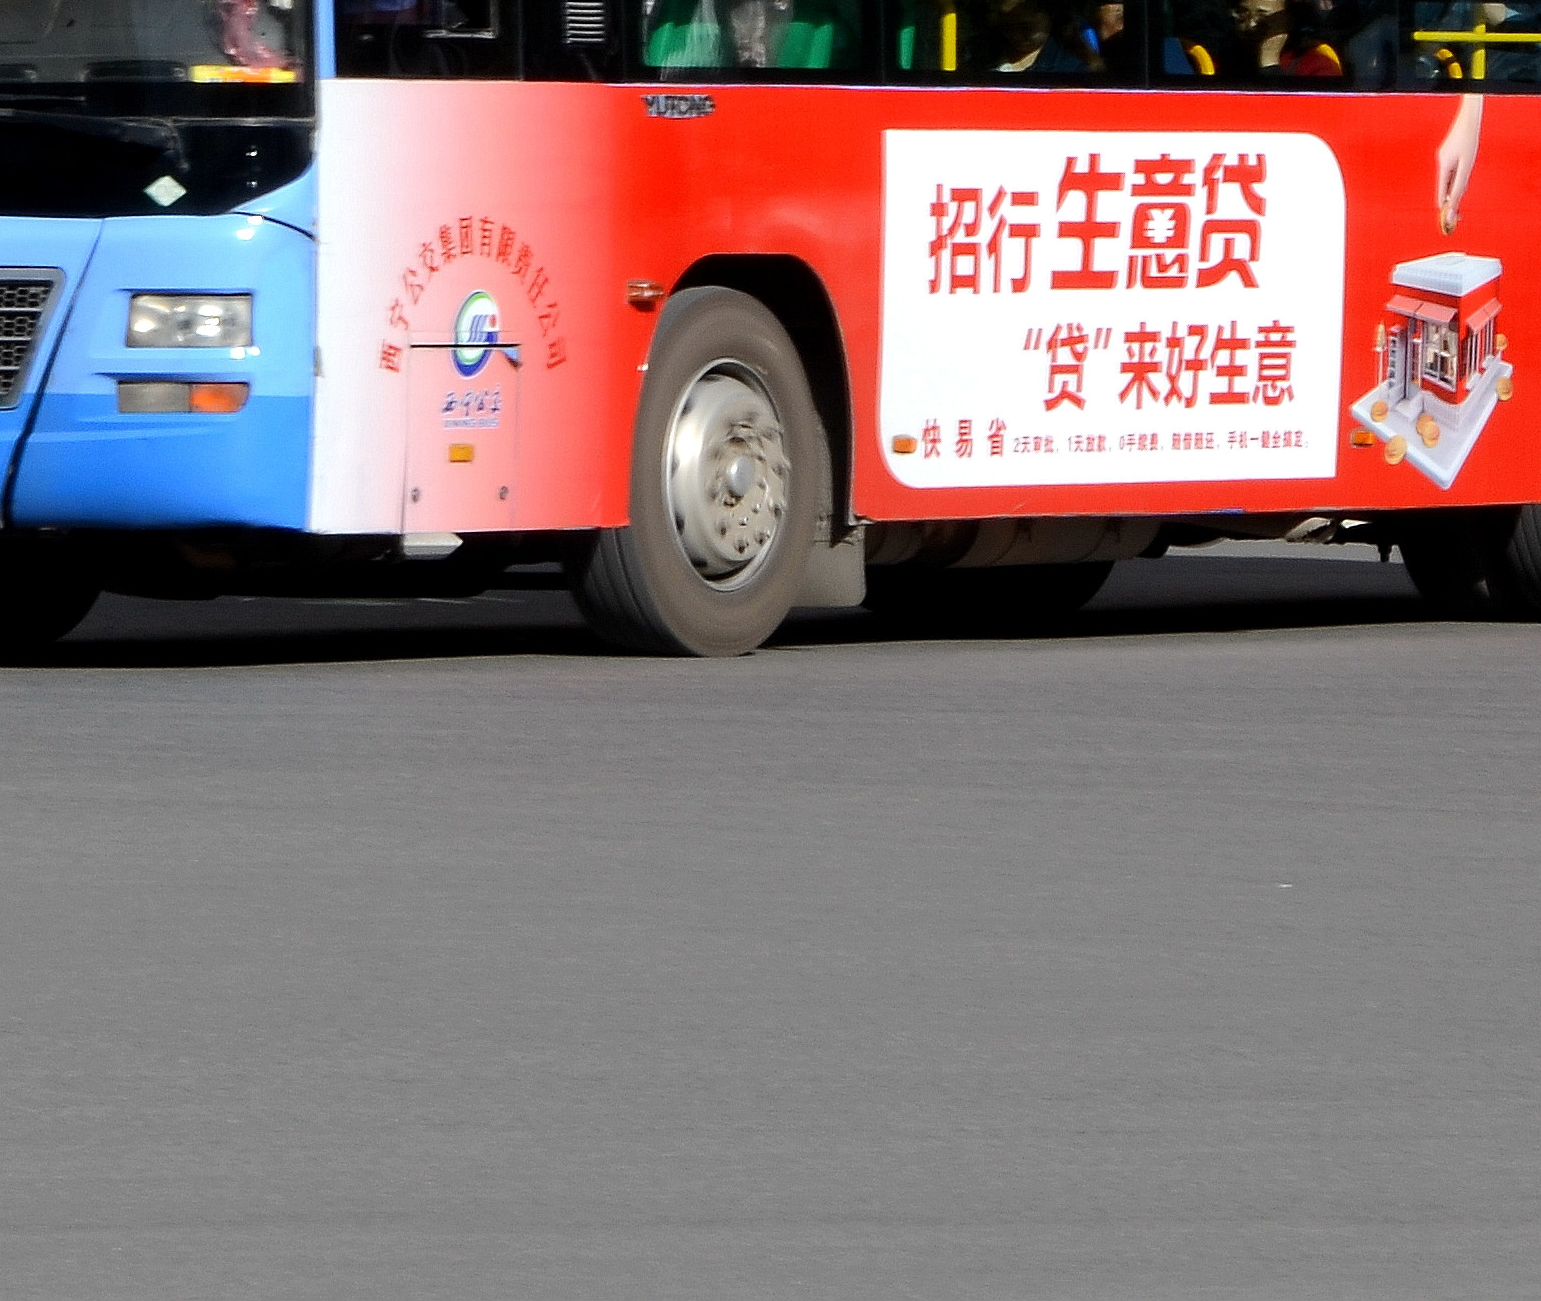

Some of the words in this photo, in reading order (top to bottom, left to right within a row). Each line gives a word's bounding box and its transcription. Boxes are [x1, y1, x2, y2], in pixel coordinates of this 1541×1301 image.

[928, 152, 1268, 296] 招行生意贷
[921, 416, 1008, 461] 快易省
